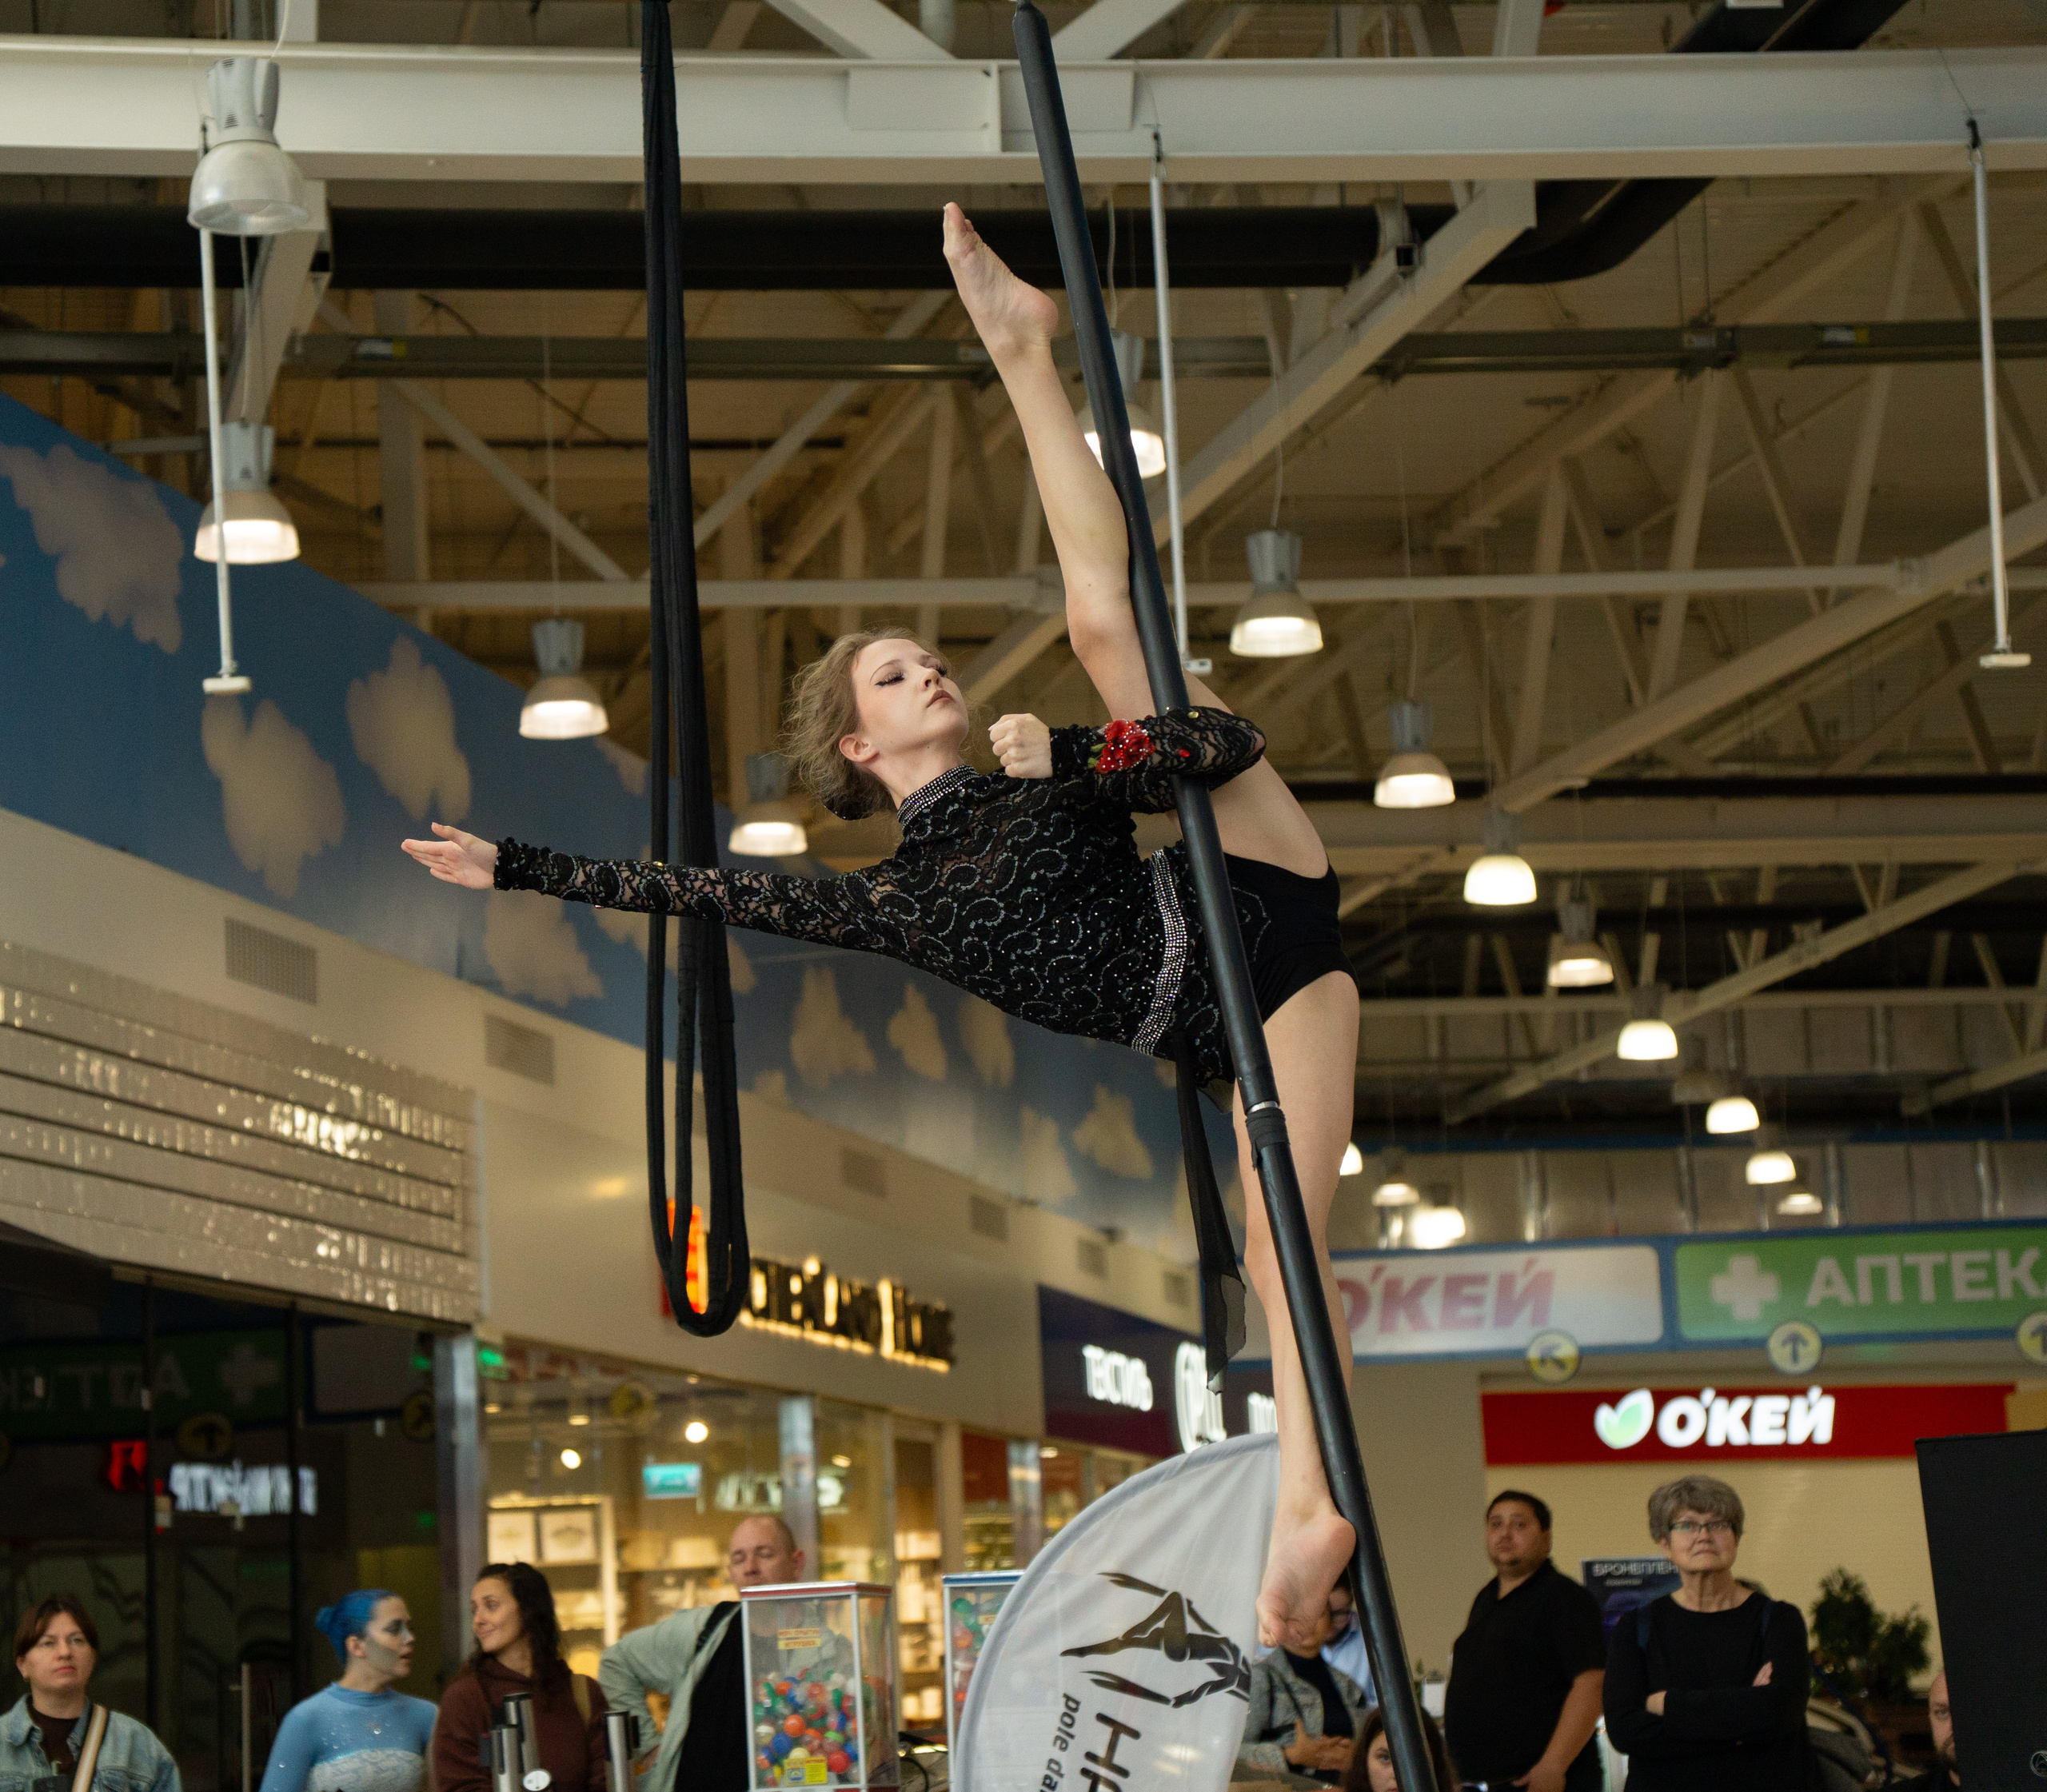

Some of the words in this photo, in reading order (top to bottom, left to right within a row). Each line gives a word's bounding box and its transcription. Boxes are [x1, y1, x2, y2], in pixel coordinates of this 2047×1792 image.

[1806, 1247, 2047, 1307] АПТЕК
[1657, 1385, 1835, 1448] О'КЕЙ
[1593, 1562, 1679, 1577] БРОНЕПЛЕН
[1052, 1693, 1082, 1752] pole
[1039, 1758, 1065, 1792] da
